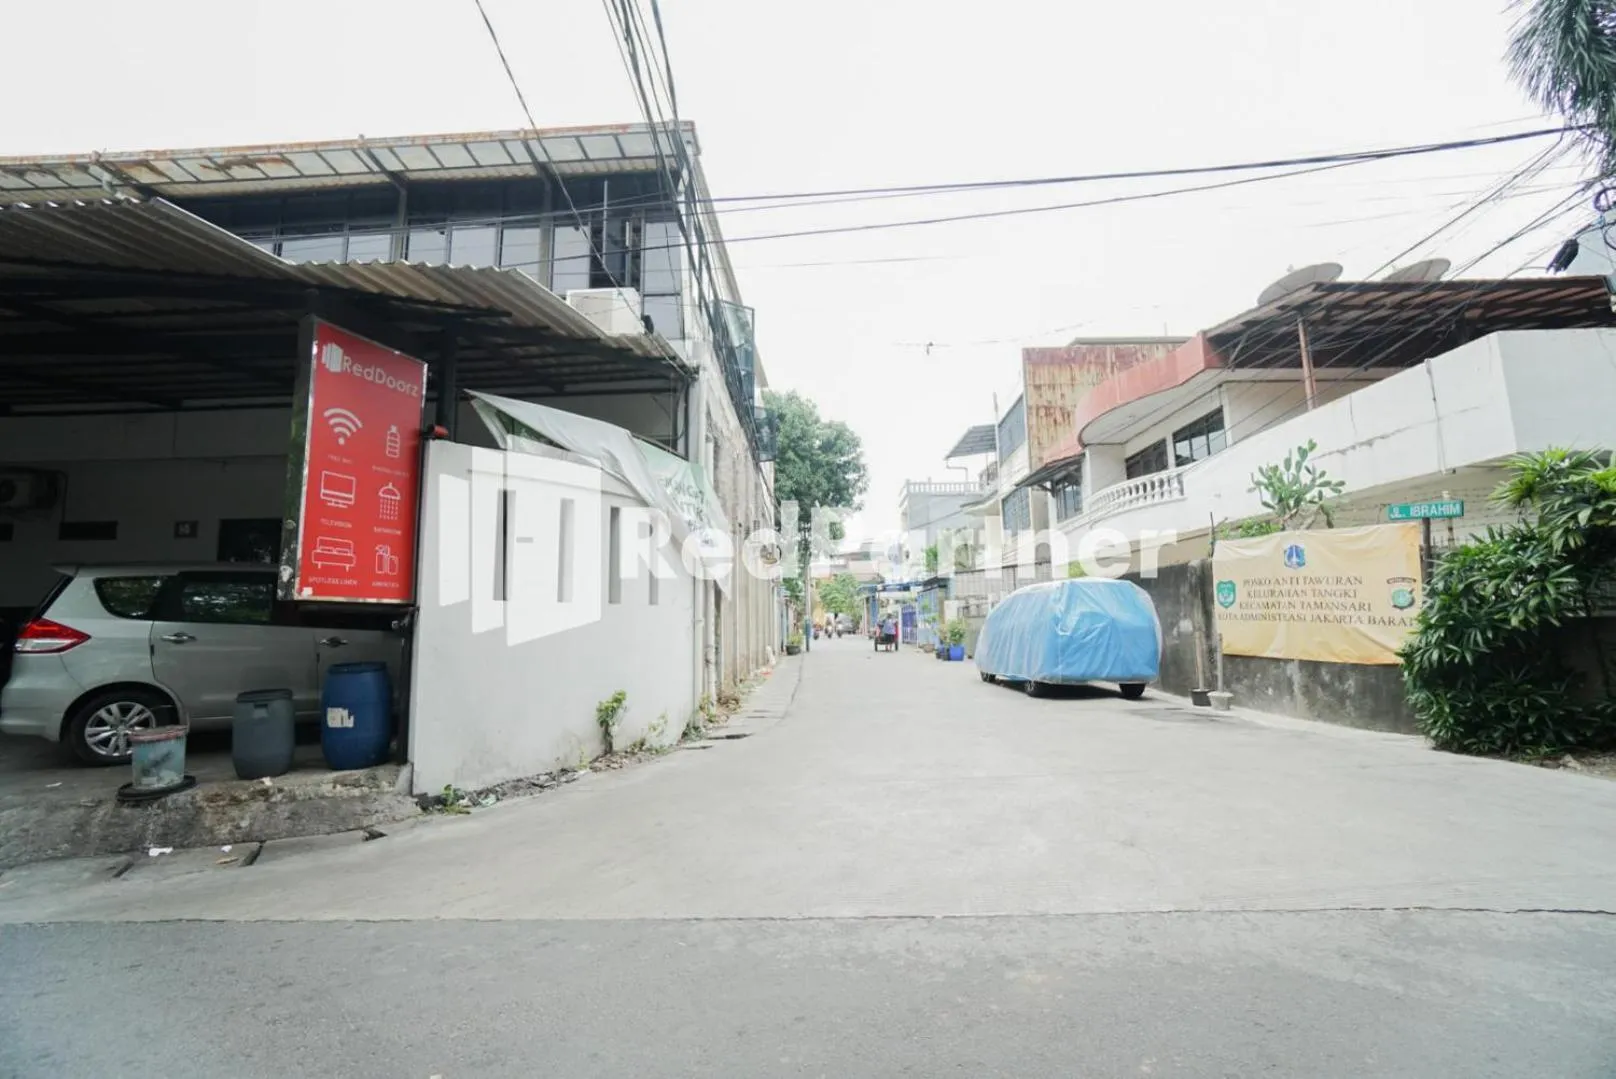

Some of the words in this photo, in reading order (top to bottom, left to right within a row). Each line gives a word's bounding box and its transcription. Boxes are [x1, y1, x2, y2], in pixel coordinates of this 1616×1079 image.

[343, 355, 418, 397] RedDoorz
[1409, 503, 1461, 517] IBRAHIM
[1273, 577, 1300, 586] ANTI
[1302, 575, 1363, 586] TAWURAN
[1312, 588, 1357, 599] TANGKI
[1240, 601, 1296, 611] KECAMATAN
[1301, 600, 1372, 612] TAMANSARI
[1310, 613, 1364, 625] JAKARTA
